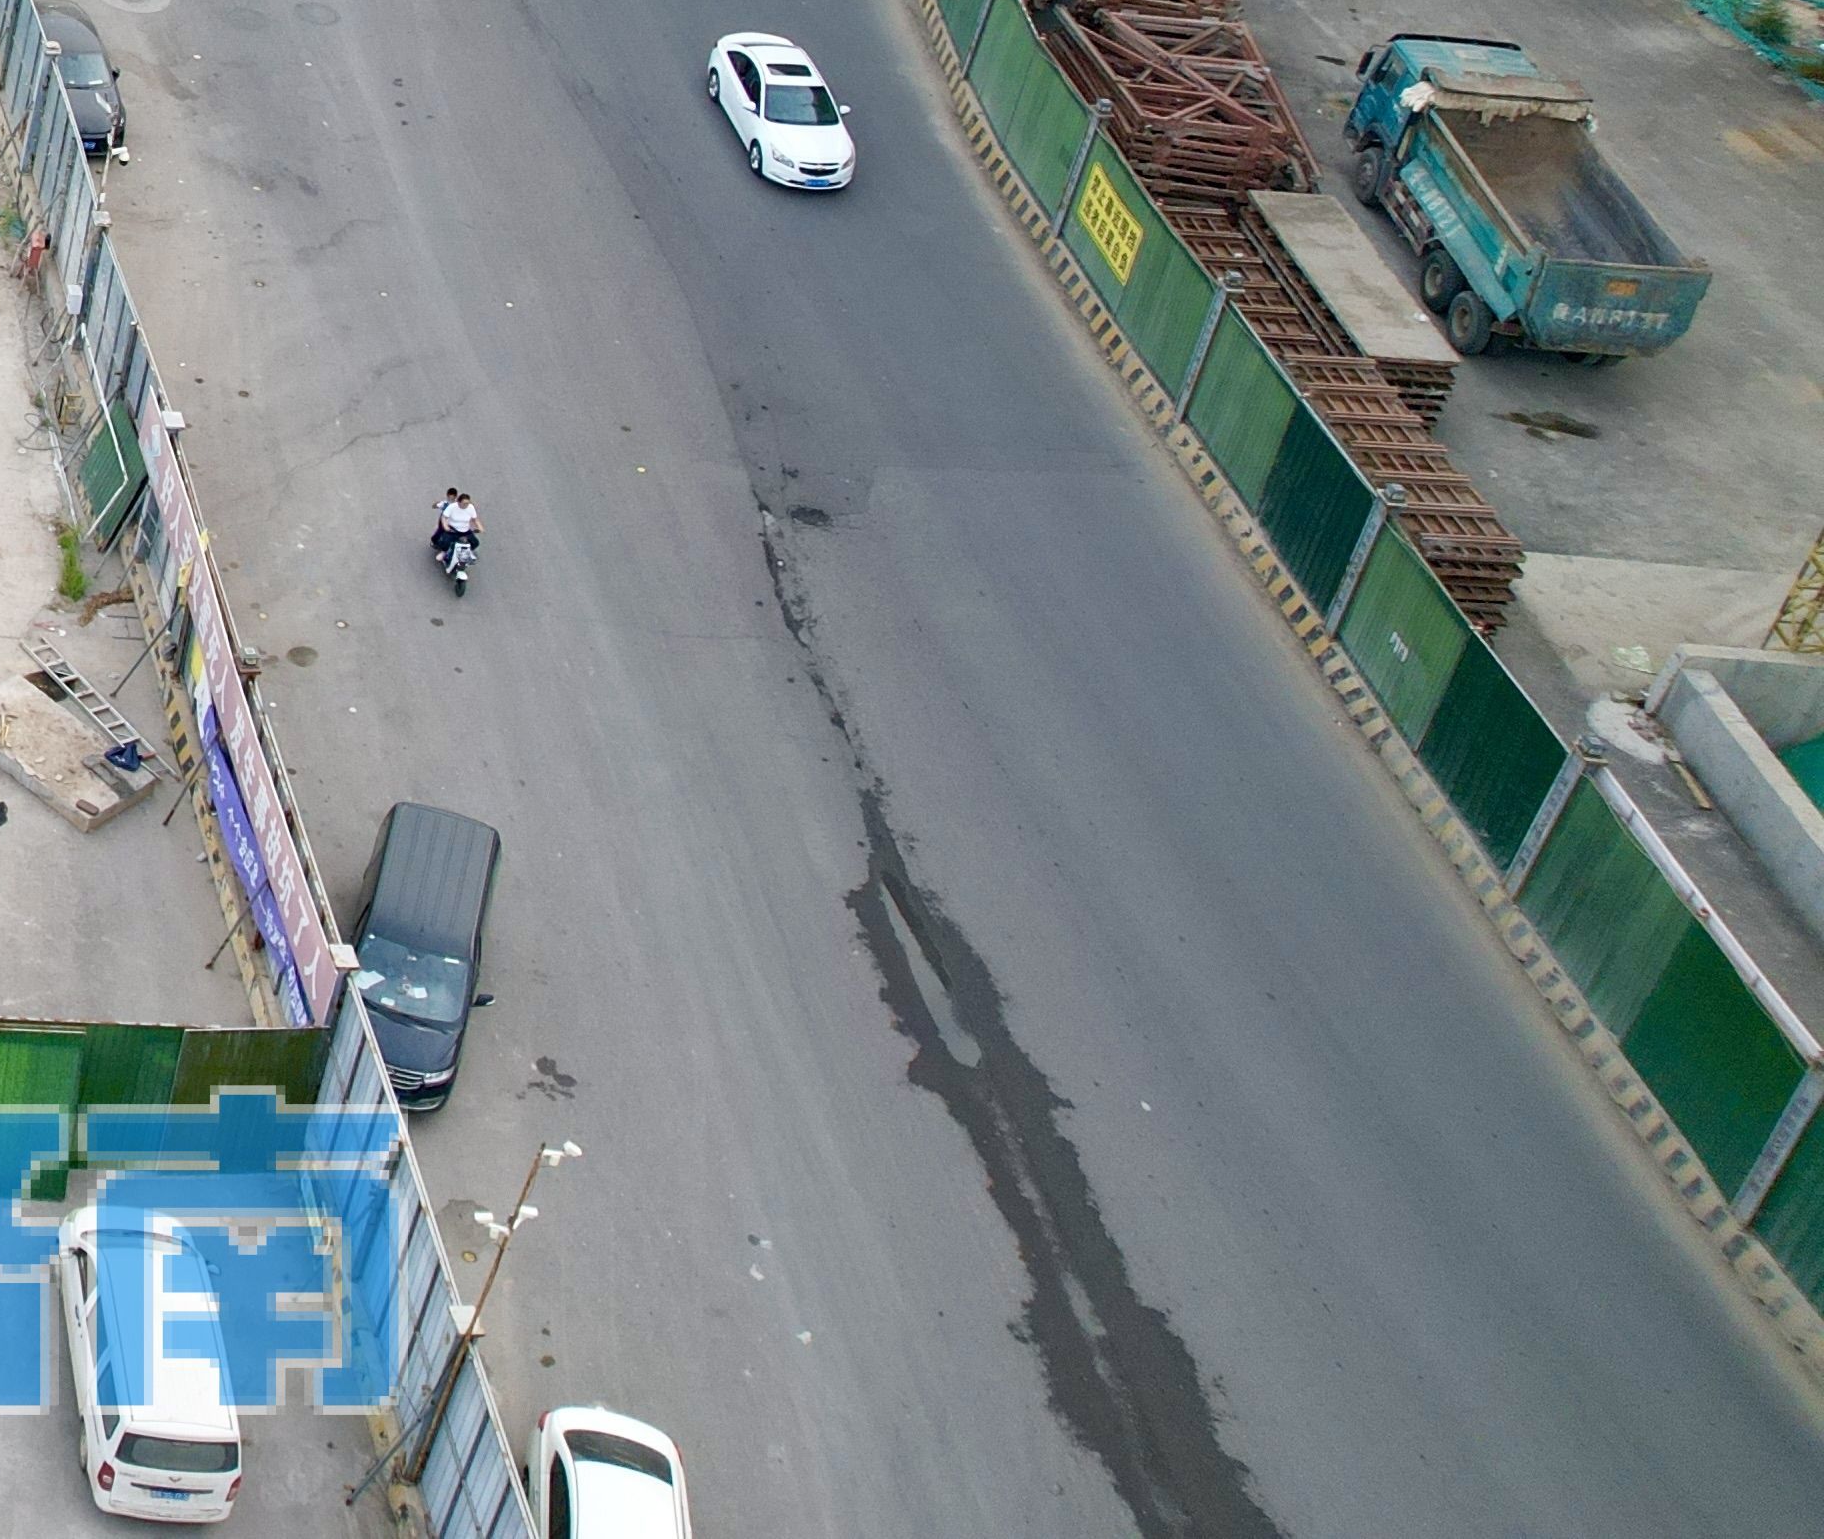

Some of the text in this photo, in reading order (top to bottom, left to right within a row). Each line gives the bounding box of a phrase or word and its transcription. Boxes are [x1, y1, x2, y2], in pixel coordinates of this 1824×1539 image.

[229, 705, 321, 1002] 发生事故坑了人
